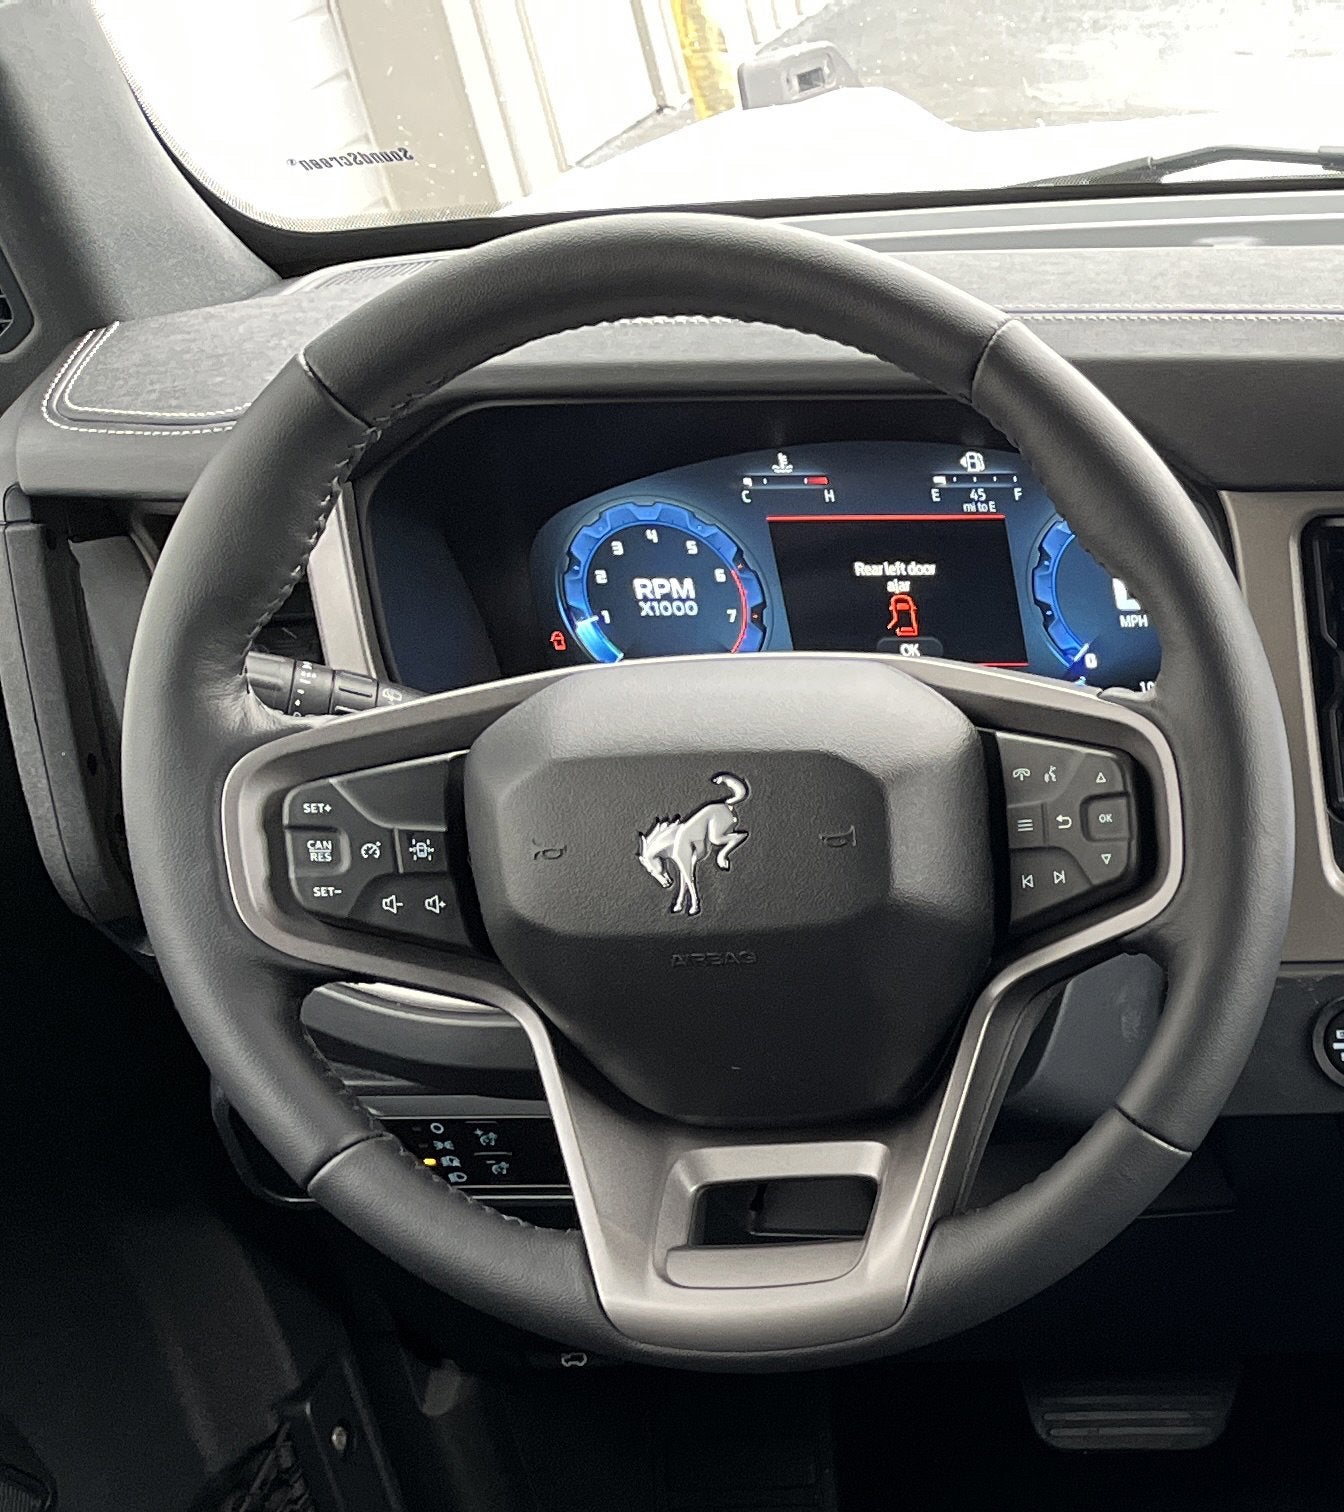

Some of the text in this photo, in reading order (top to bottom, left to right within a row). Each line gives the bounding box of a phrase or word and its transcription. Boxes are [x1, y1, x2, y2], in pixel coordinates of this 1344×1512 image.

[741, 490, 751, 503] C
[823, 489, 835, 502] H
[931, 489, 941, 502] E
[969, 488, 987, 501] 45
[1013, 487, 1022, 500] F
[963, 502, 996, 512] mi to E
[645, 529, 658, 543] 4
[611, 540, 624, 555] 3
[685, 540, 698, 555] 5
[714, 568, 727, 582] 6
[854, 561, 936, 576] Rear left door
[594, 569, 608, 584] 2
[632, 577, 696, 600] RPM
[887, 580, 911, 594] ajar
[600, 609, 611, 624] 1
[726, 608, 737, 623] 7
[1119, 614, 1149, 628] MPH
[900, 643, 920, 657] OK
[1085, 653, 1098, 669] 0
[303, 803, 332, 814] SET+
[1098, 813, 1113, 823] OK
[306, 840, 332, 850] CAN
[309, 852, 332, 862] RES
